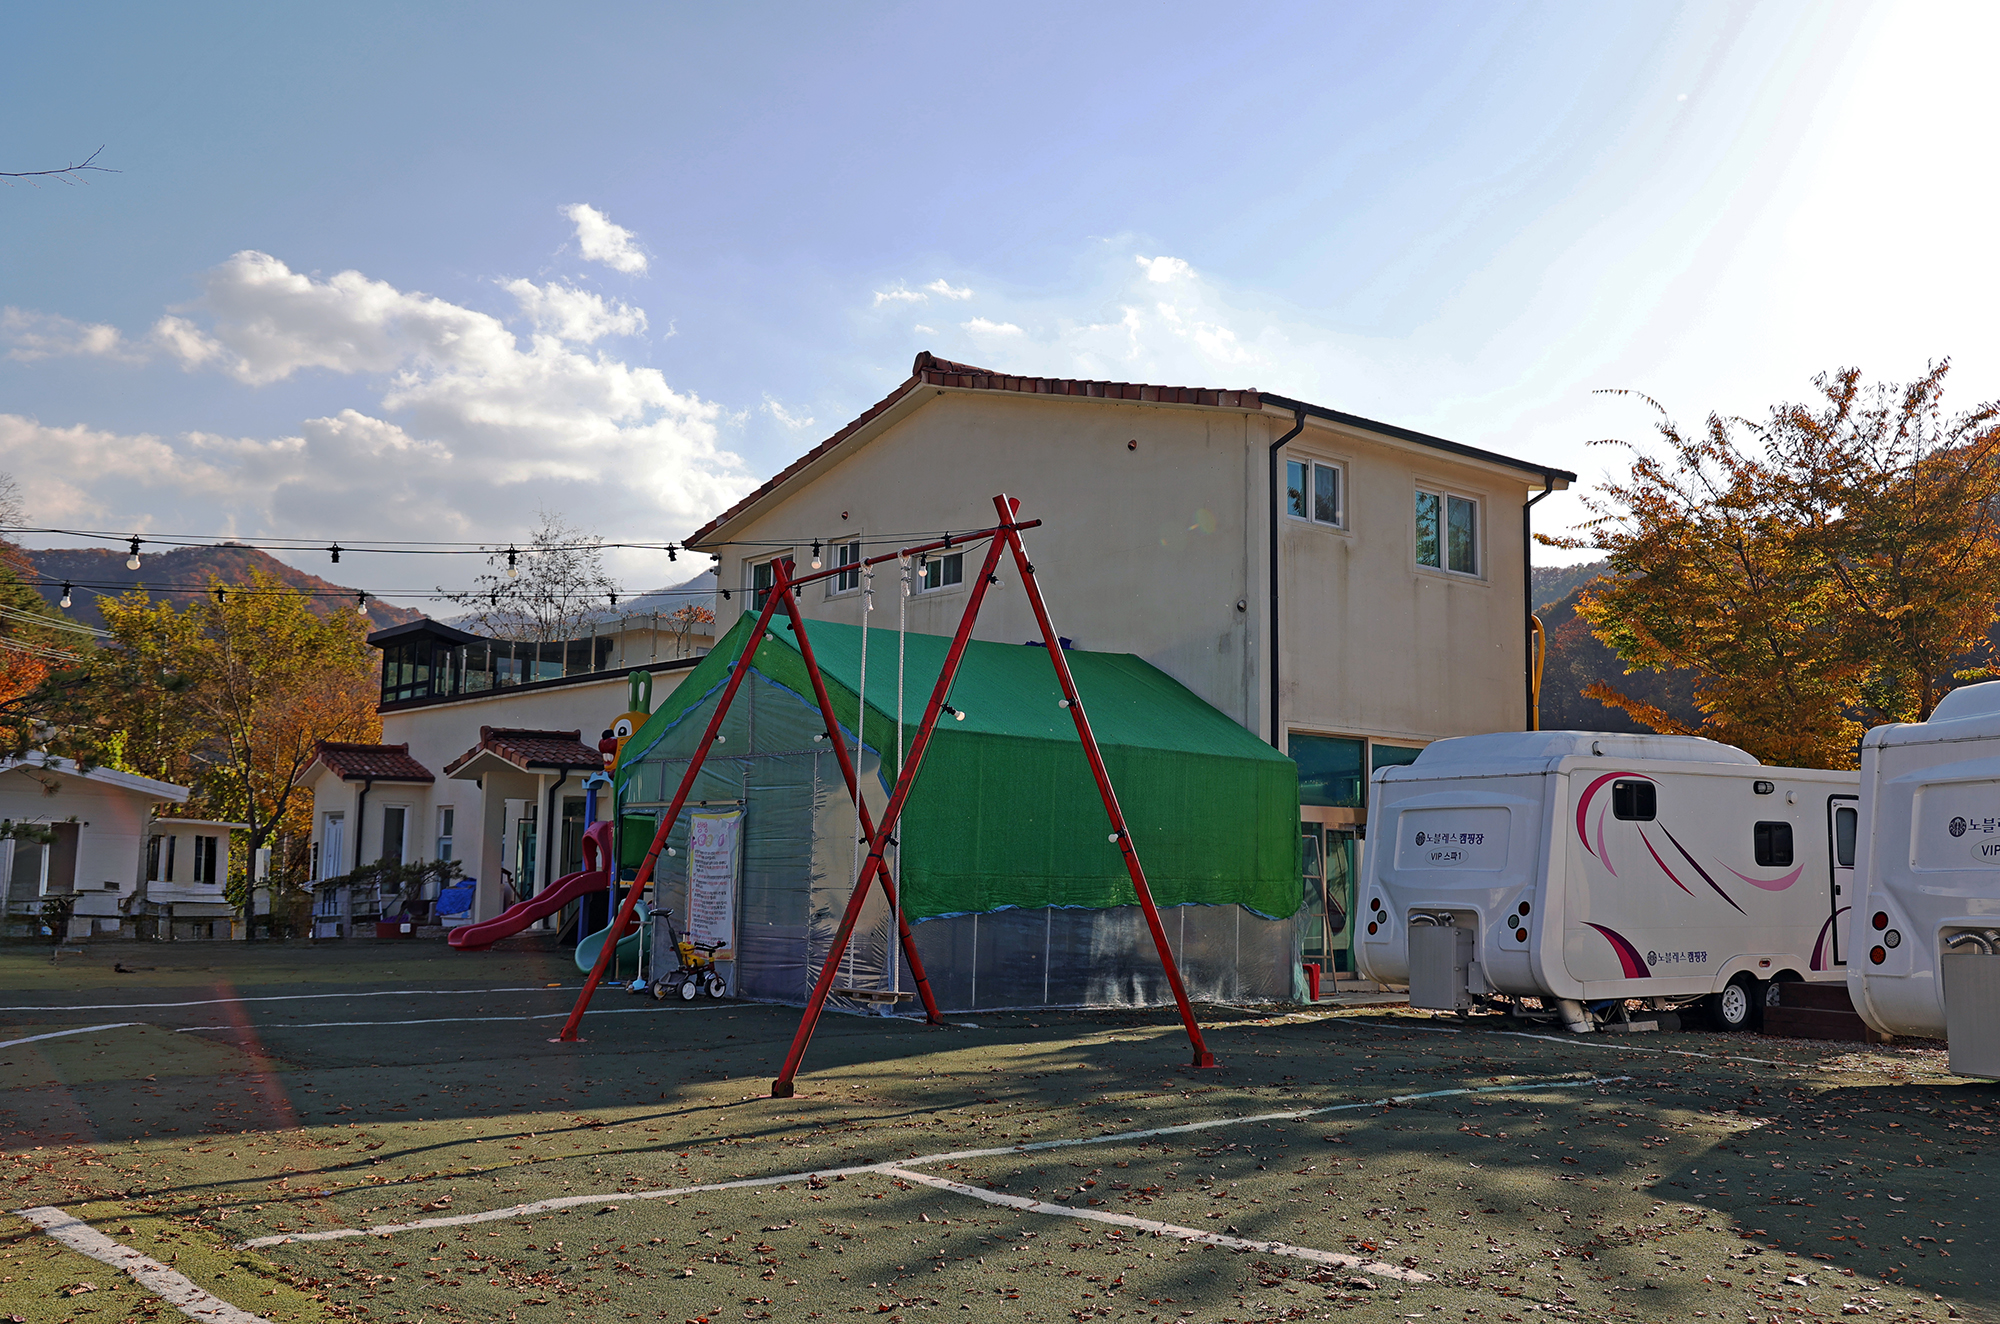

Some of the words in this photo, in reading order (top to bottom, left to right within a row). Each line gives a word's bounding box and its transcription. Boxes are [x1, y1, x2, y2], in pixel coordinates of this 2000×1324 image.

[1968, 817, 2000, 833] 노블
[1426, 833, 1457, 844] 노블레스
[1460, 833, 1484, 845] 캠핑장
[1981, 844, 2000, 856] VIP
[1431, 852, 1442, 861] VIP
[1658, 952, 1686, 964] 노블레스
[1688, 951, 1707, 963] 캠핑장
